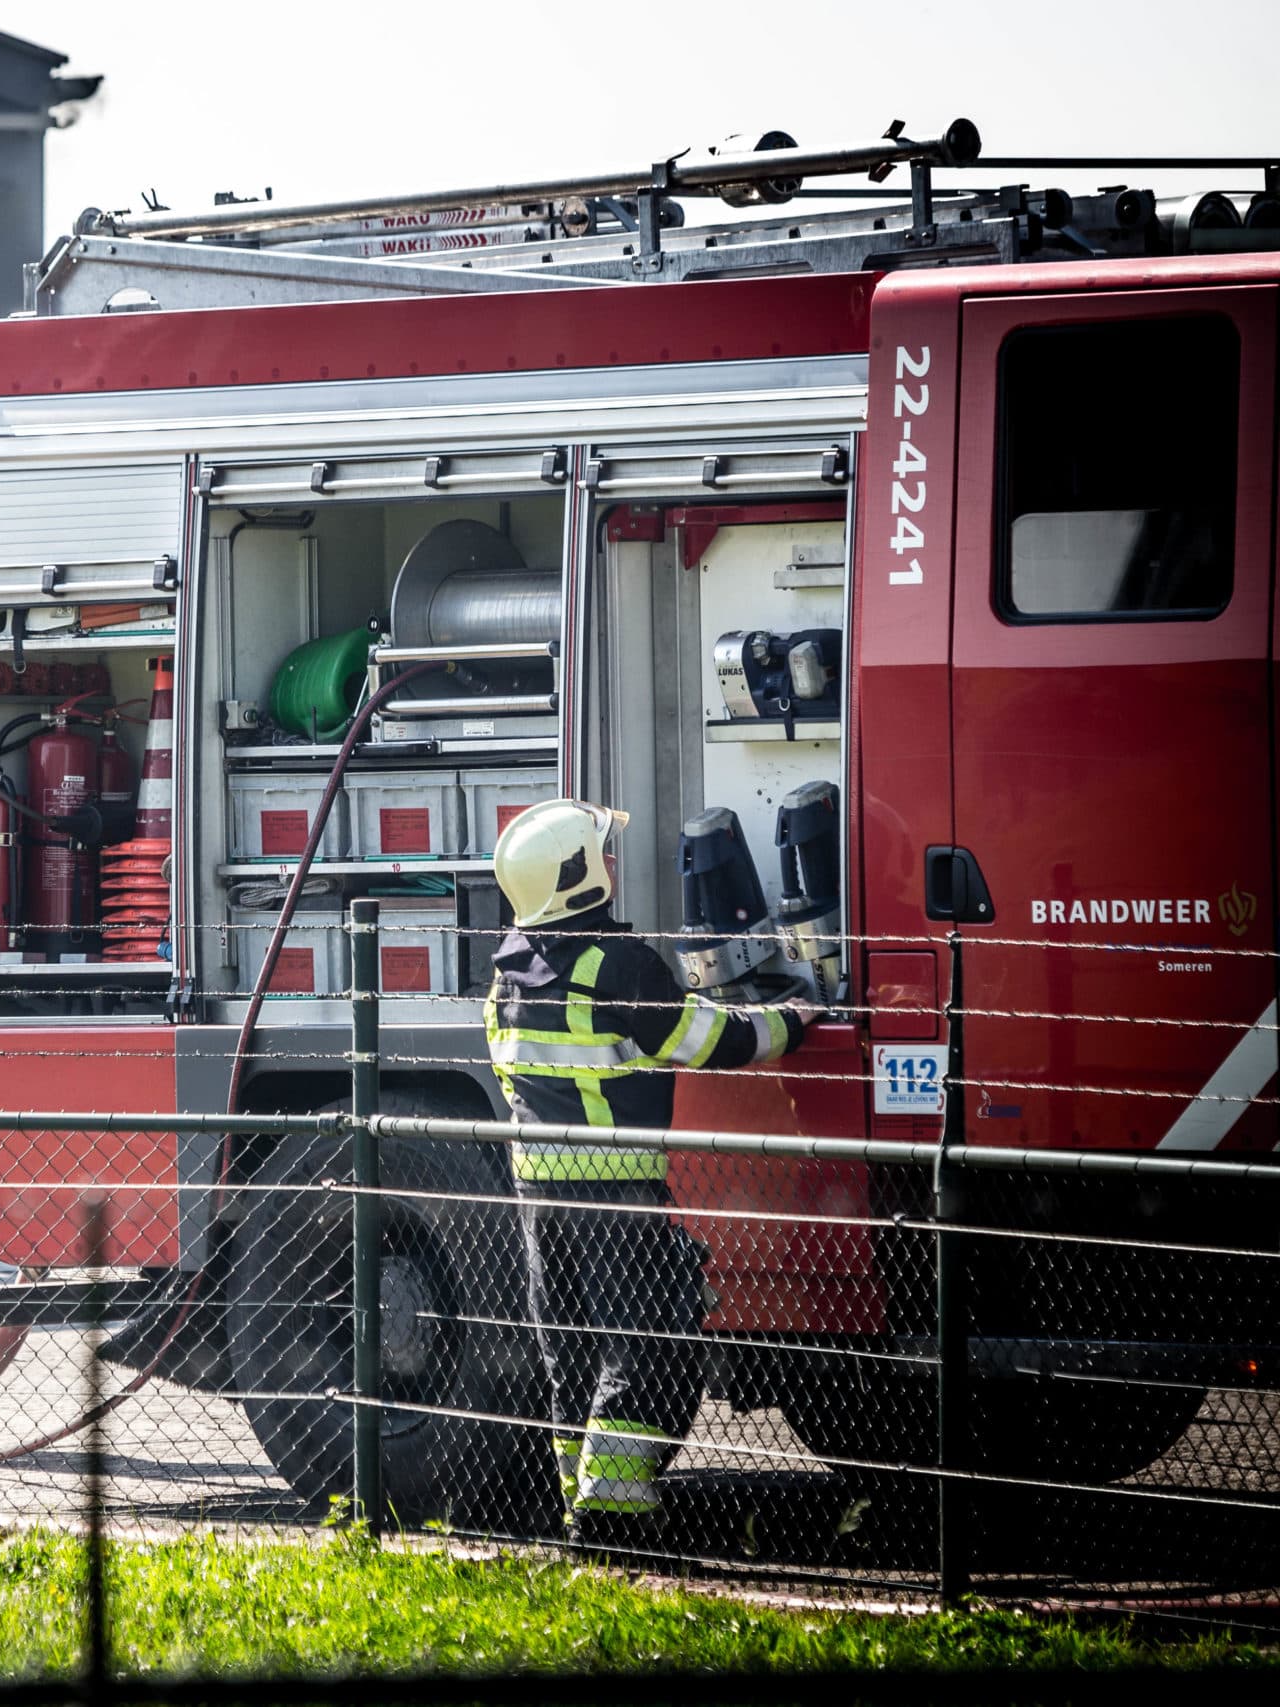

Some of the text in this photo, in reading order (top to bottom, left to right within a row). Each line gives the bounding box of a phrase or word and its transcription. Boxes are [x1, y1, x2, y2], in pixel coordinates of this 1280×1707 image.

[889, 346, 930, 585] 22-4241
[718, 667, 744, 676] LUKAS
[391, 863, 401, 873] 10
[1031, 900, 1212, 924] BRANDWEER
[1158, 960, 1212, 972] Someren
